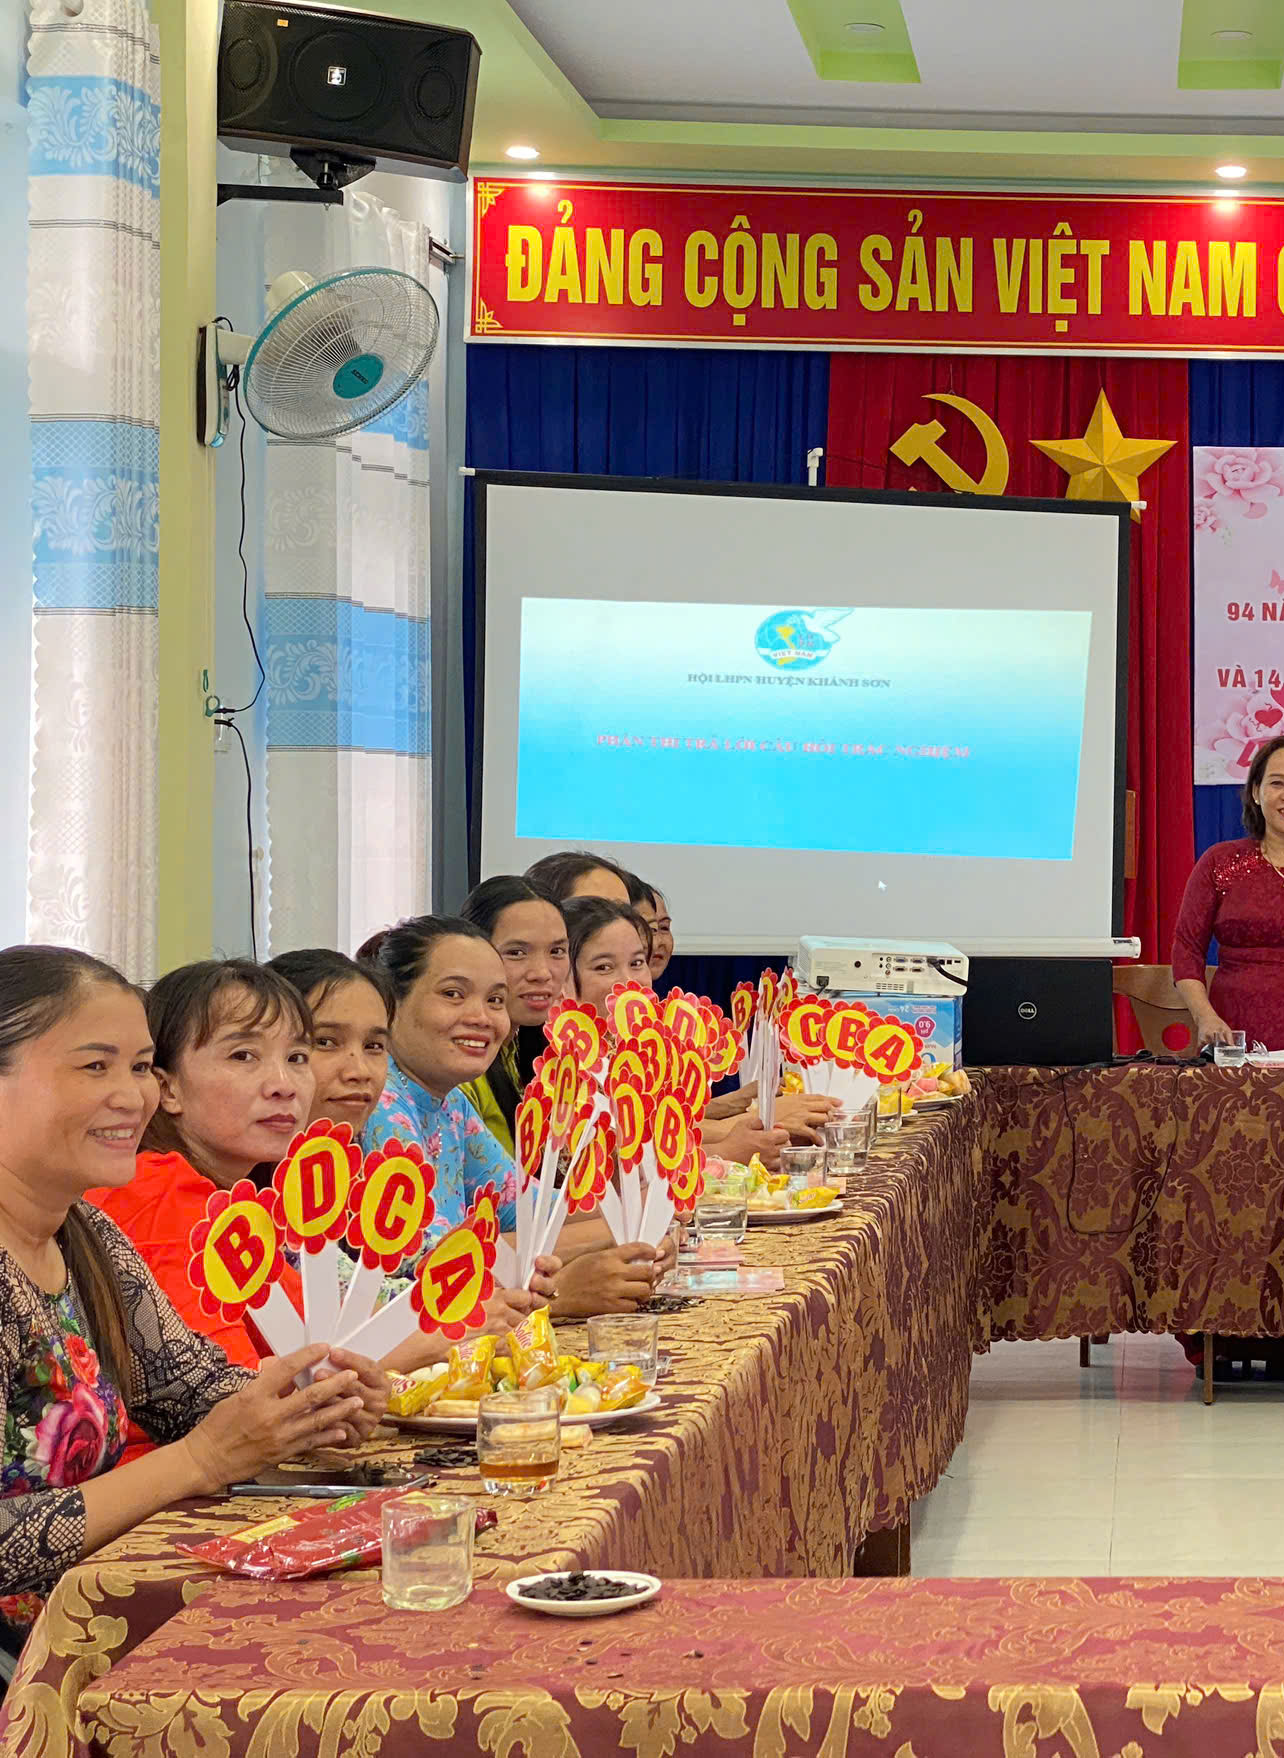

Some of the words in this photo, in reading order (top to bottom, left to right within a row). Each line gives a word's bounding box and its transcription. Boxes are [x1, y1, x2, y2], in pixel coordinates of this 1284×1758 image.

[505, 200, 663, 306] ĐẢNG
[684, 214, 838, 326] CỘNG
[858, 209, 974, 313] SẢN
[993, 222, 1111, 333] VIỆT
[1129, 240, 1257, 318] NAM
[1227, 602, 1255, 621] 94
[1217, 665, 1247, 688] VÀ
[799, 1012, 825, 1047] C
[837, 1016, 858, 1052] B
[870, 1034, 905, 1072] A
[618, 1096, 637, 1151] D
[659, 1104, 681, 1157] B
[300, 1150, 337, 1225] D
[374, 1172, 416, 1241] C
[213, 1215, 265, 1292] B
[429, 1252, 476, 1316] A
